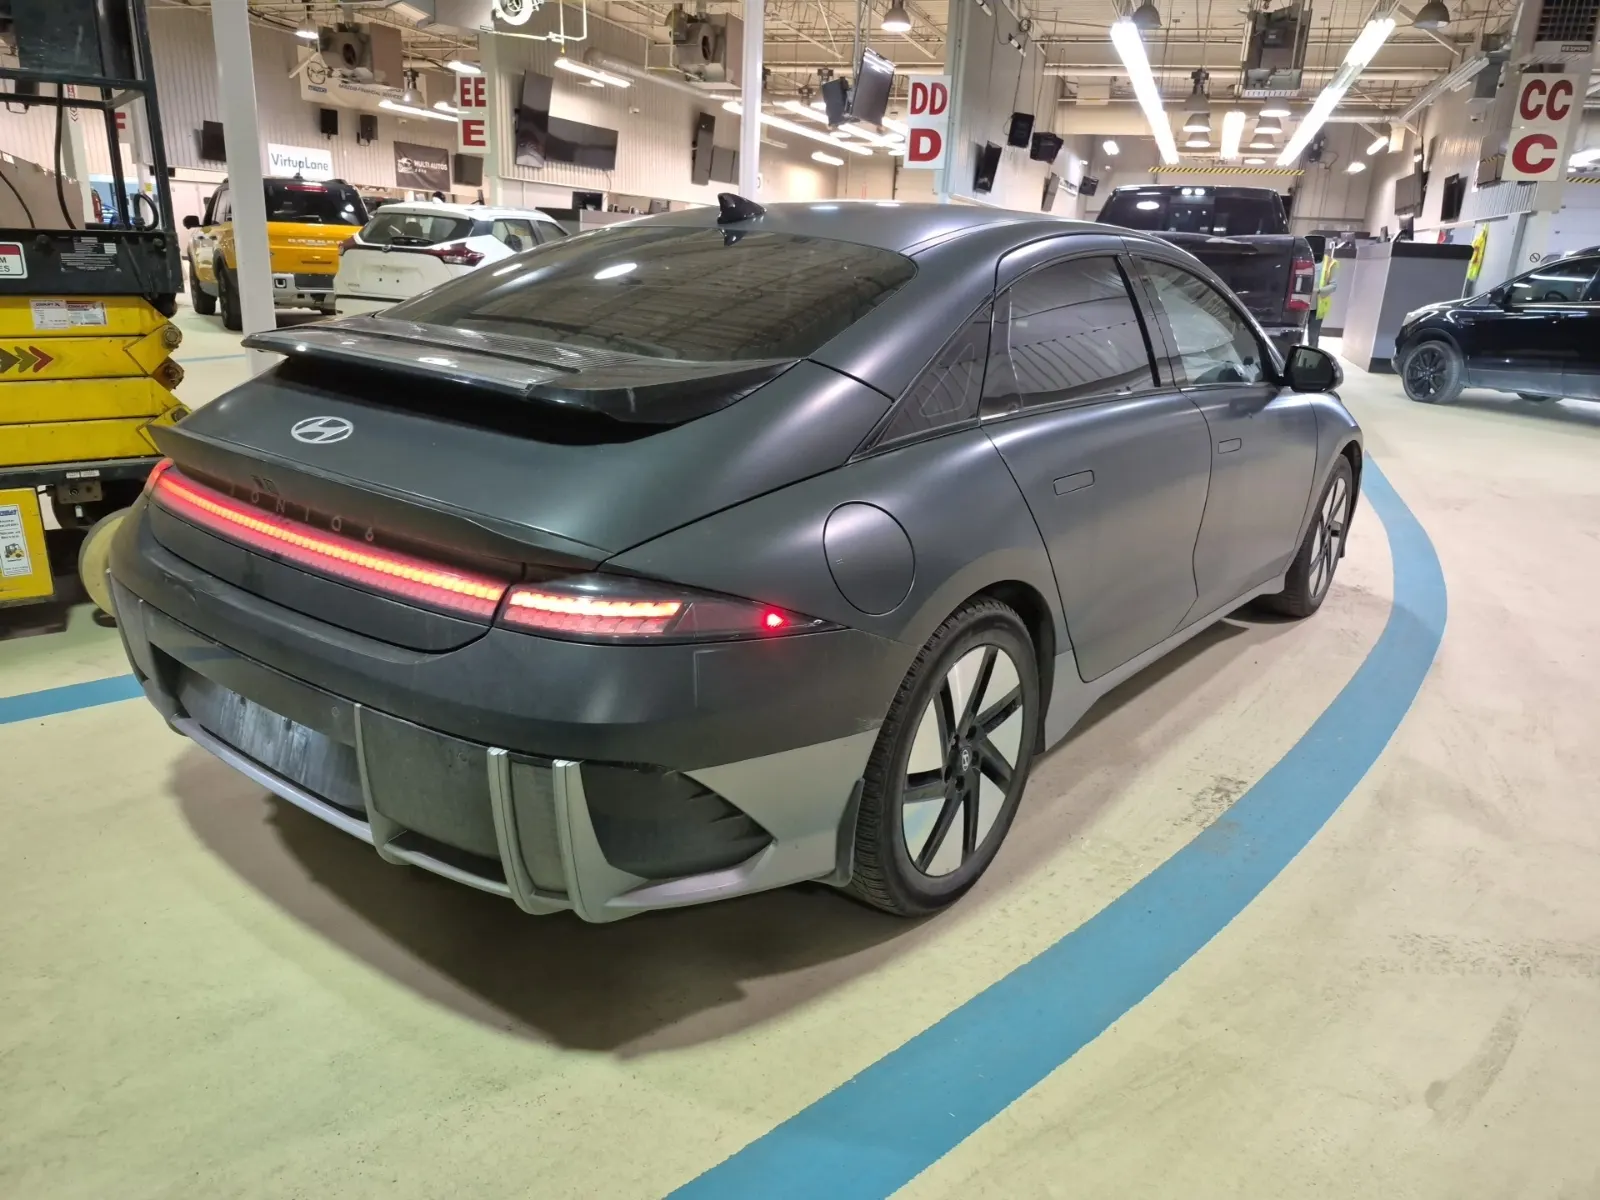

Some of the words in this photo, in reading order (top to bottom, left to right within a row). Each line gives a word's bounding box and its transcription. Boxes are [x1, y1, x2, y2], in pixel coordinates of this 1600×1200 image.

[459, 77, 486, 107] EE
[910, 82, 948, 115] DD
[1520, 79, 1573, 121] CC
[463, 120, 486, 147] E
[908, 128, 942, 162] D
[1511, 133, 1558, 174] C
[364, 526, 375, 542] 6
